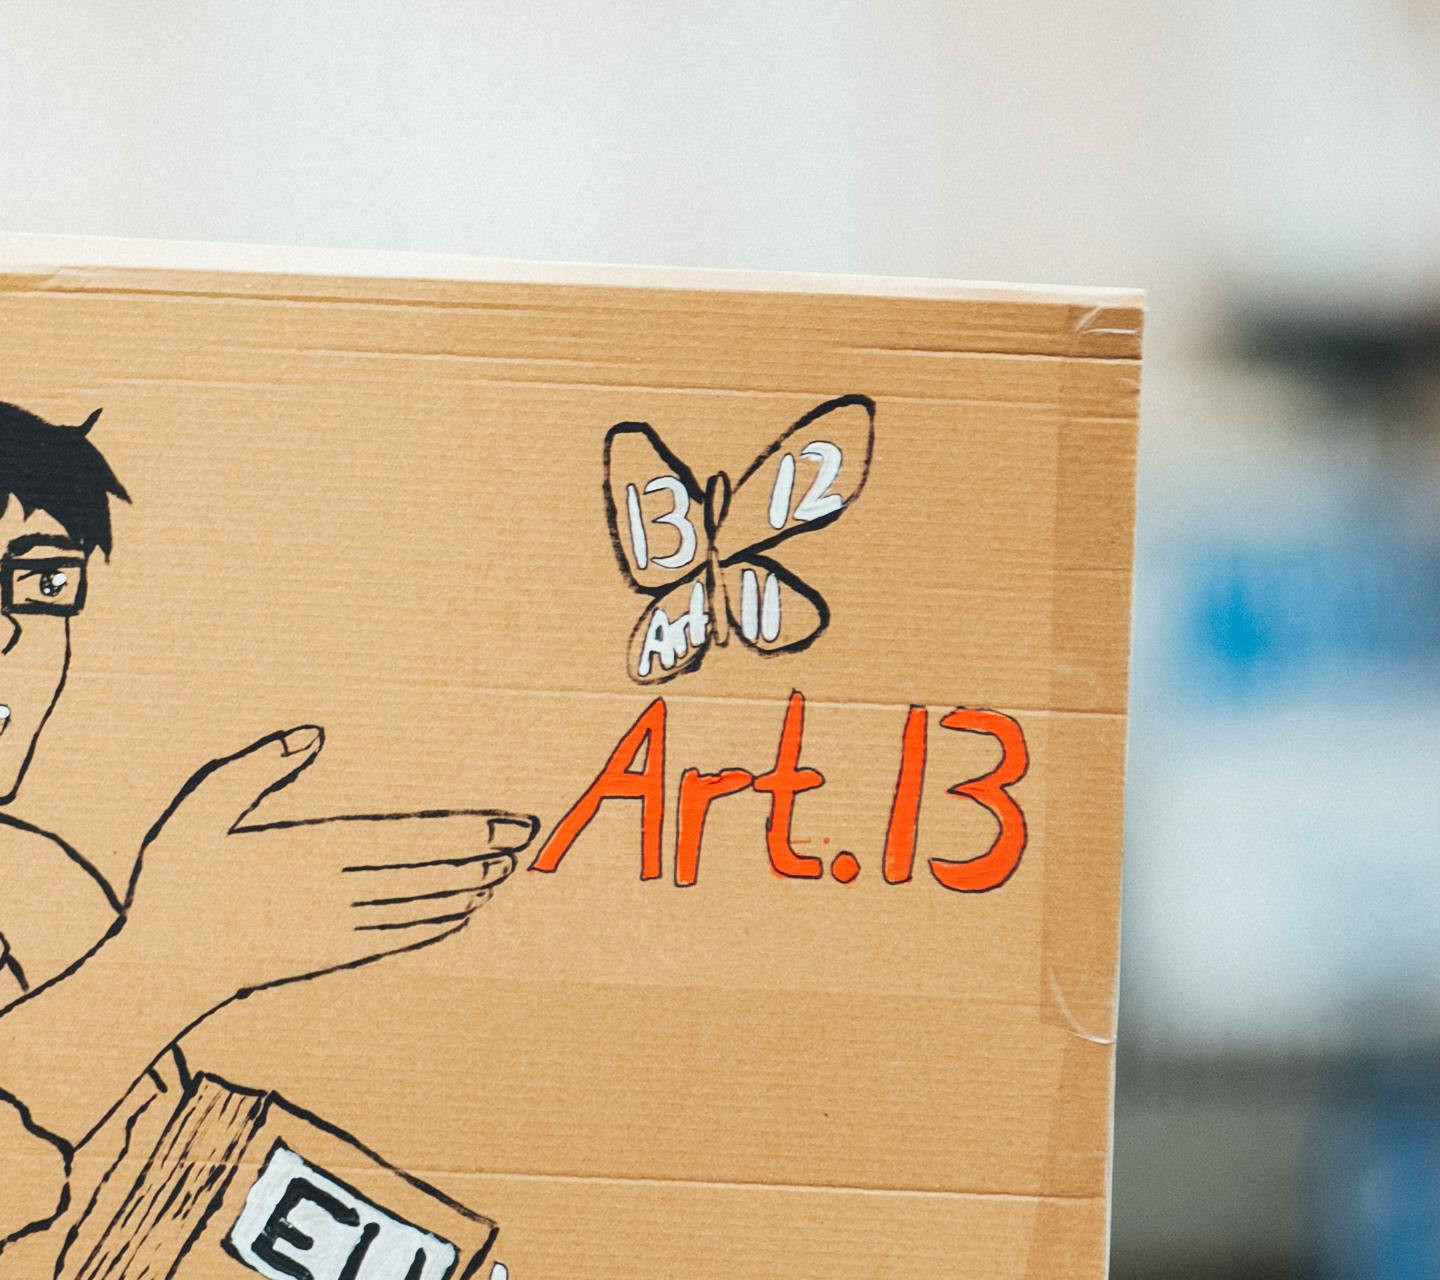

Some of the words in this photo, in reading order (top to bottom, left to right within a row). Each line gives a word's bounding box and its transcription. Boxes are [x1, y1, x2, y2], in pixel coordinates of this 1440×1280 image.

[626, 474, 698, 570] 13
[768, 439, 843, 530] 12
[637, 580, 710, 677] Art
